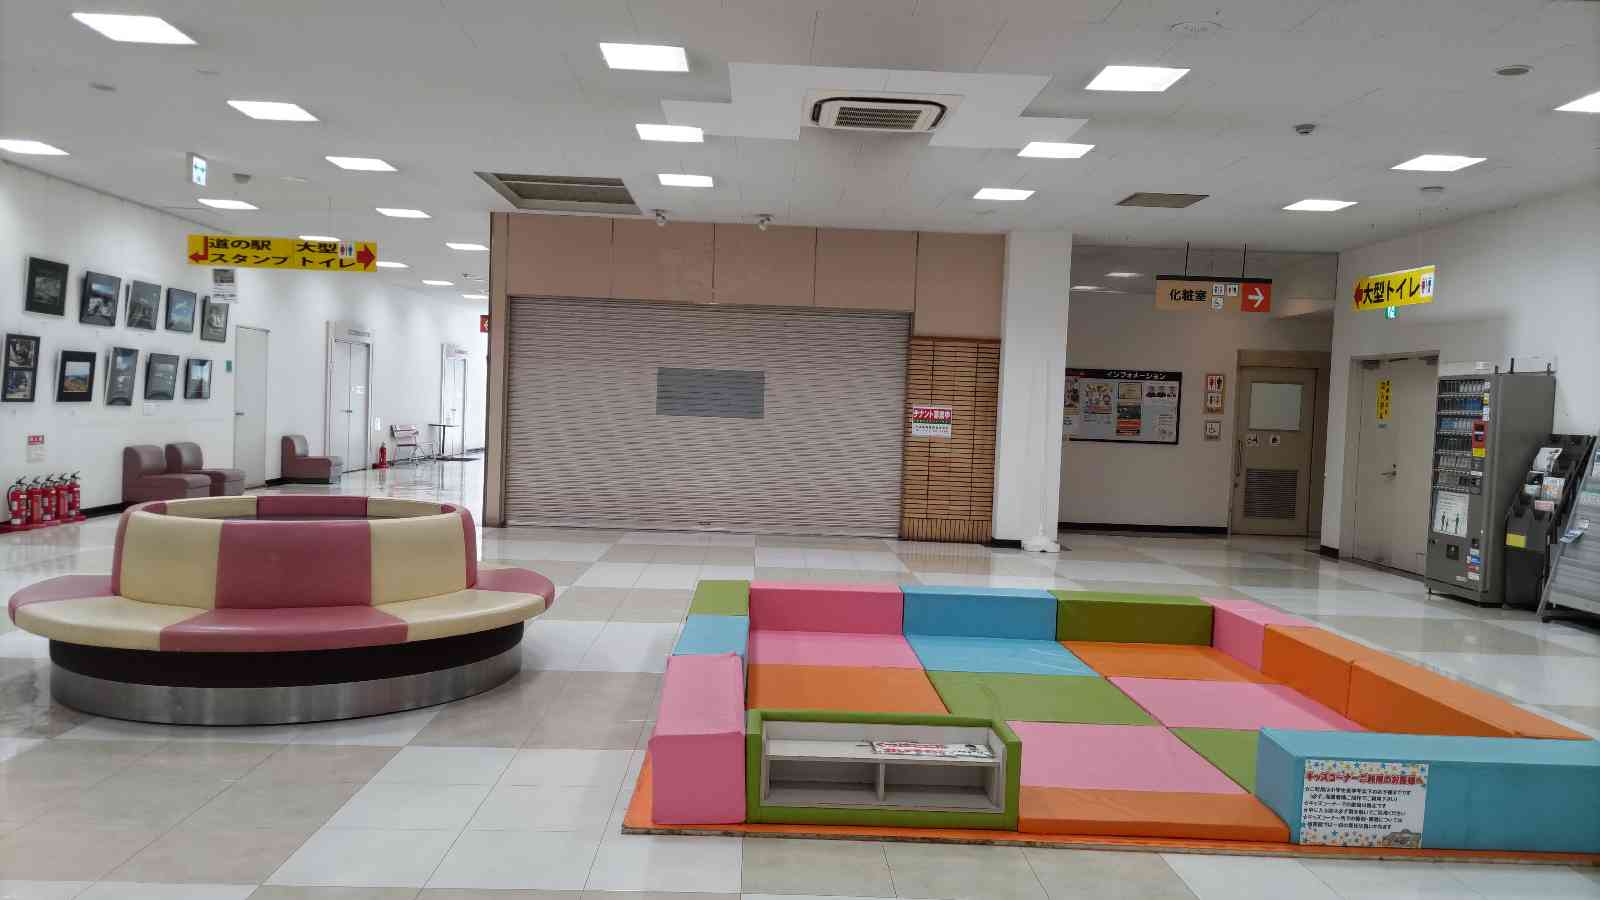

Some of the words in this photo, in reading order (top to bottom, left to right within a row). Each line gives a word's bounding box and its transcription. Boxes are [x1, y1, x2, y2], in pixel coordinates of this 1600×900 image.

[208, 238, 271, 250] 道の駅
[297, 241, 338, 254] 大型
[301, 257, 356, 269] トイレ
[1169, 288, 1208, 302] 化粧室
[1363, 276, 1421, 305] 大型トイレ
[1107, 370, 1168, 380] インフォメーション
